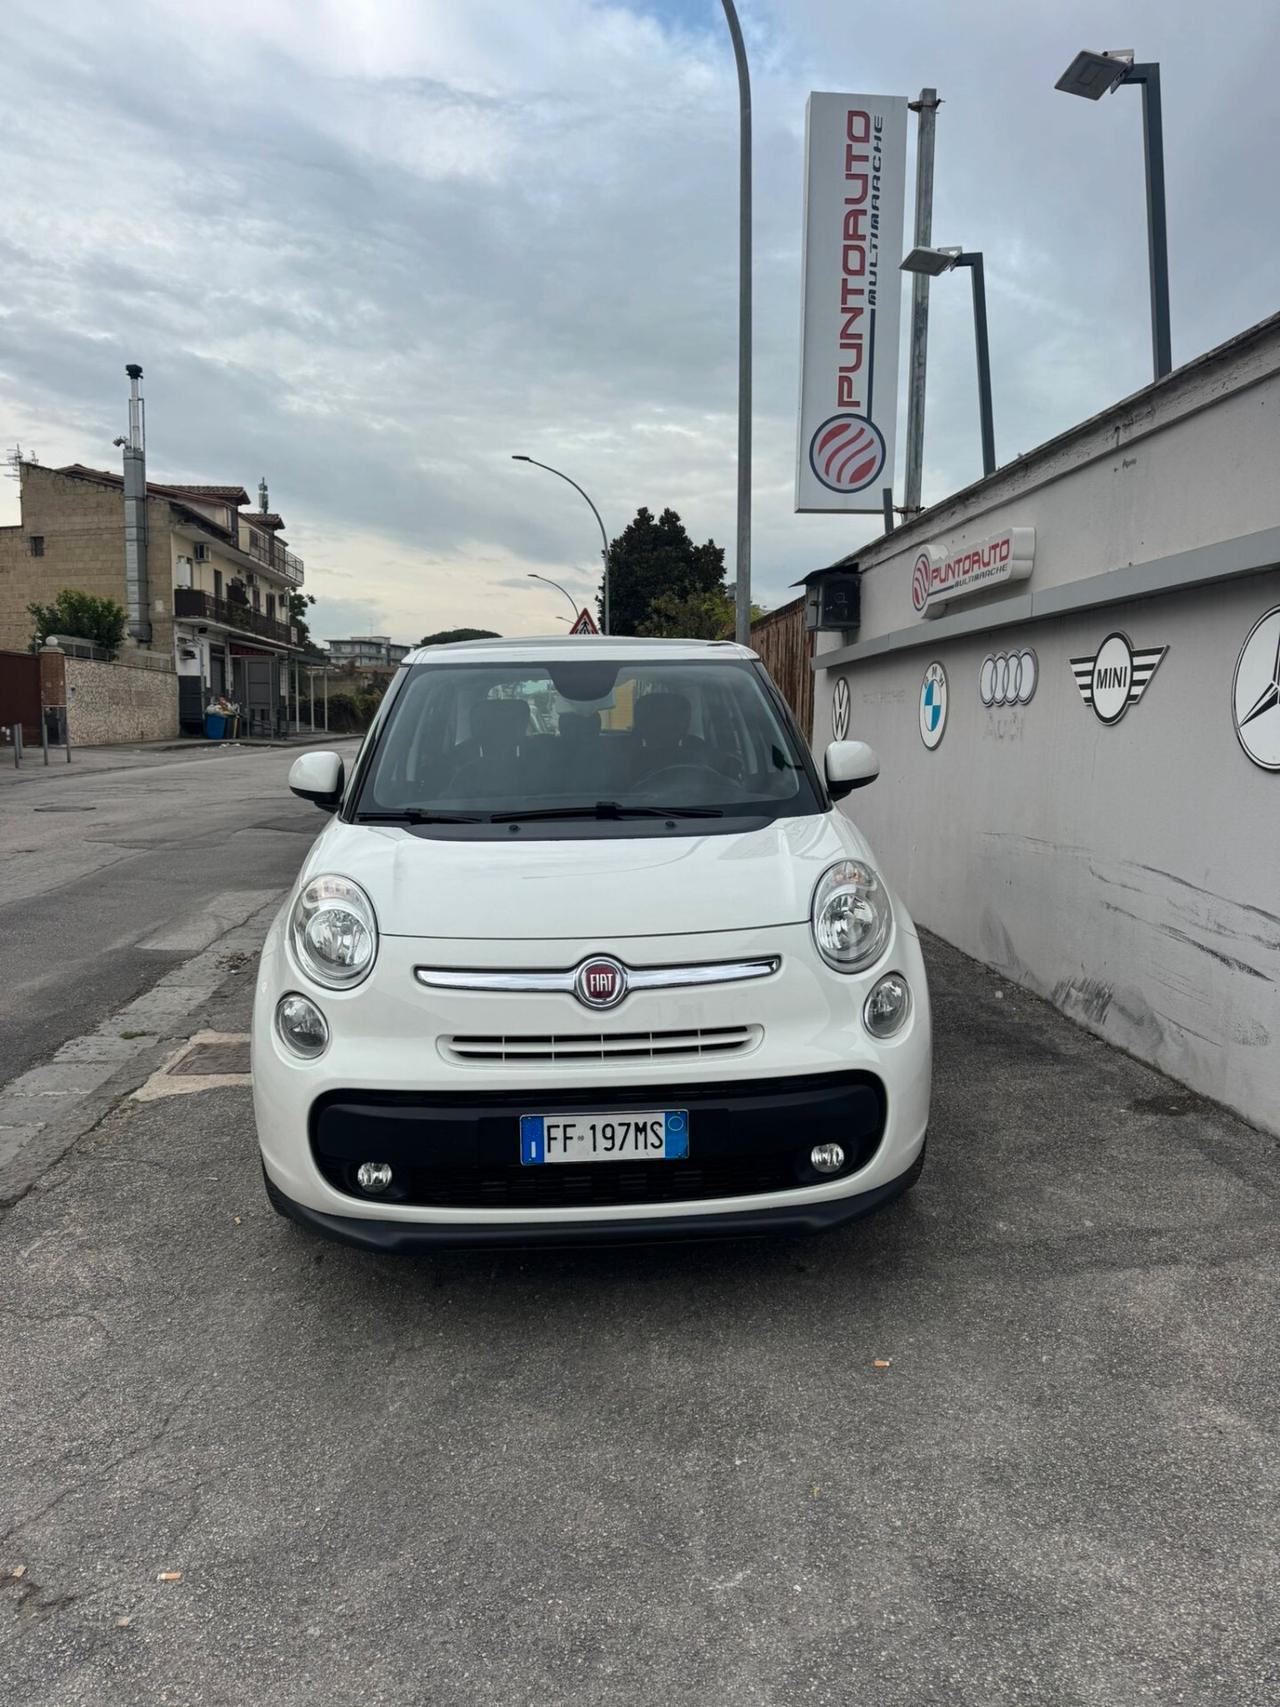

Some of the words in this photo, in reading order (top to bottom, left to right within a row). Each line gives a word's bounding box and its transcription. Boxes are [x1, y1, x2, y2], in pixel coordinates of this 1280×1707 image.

[868, 114, 884, 306] MULTIMARCHE
[837, 110, 871, 408] PUNTOAUTO
[931, 538, 1010, 588] PUNTOAUTO
[1096, 666, 1128, 690] MINI
[590, 973, 614, 992] FIAT
[546, 1124, 577, 1153] FF
[589, 1121, 663, 1152] 197MS
